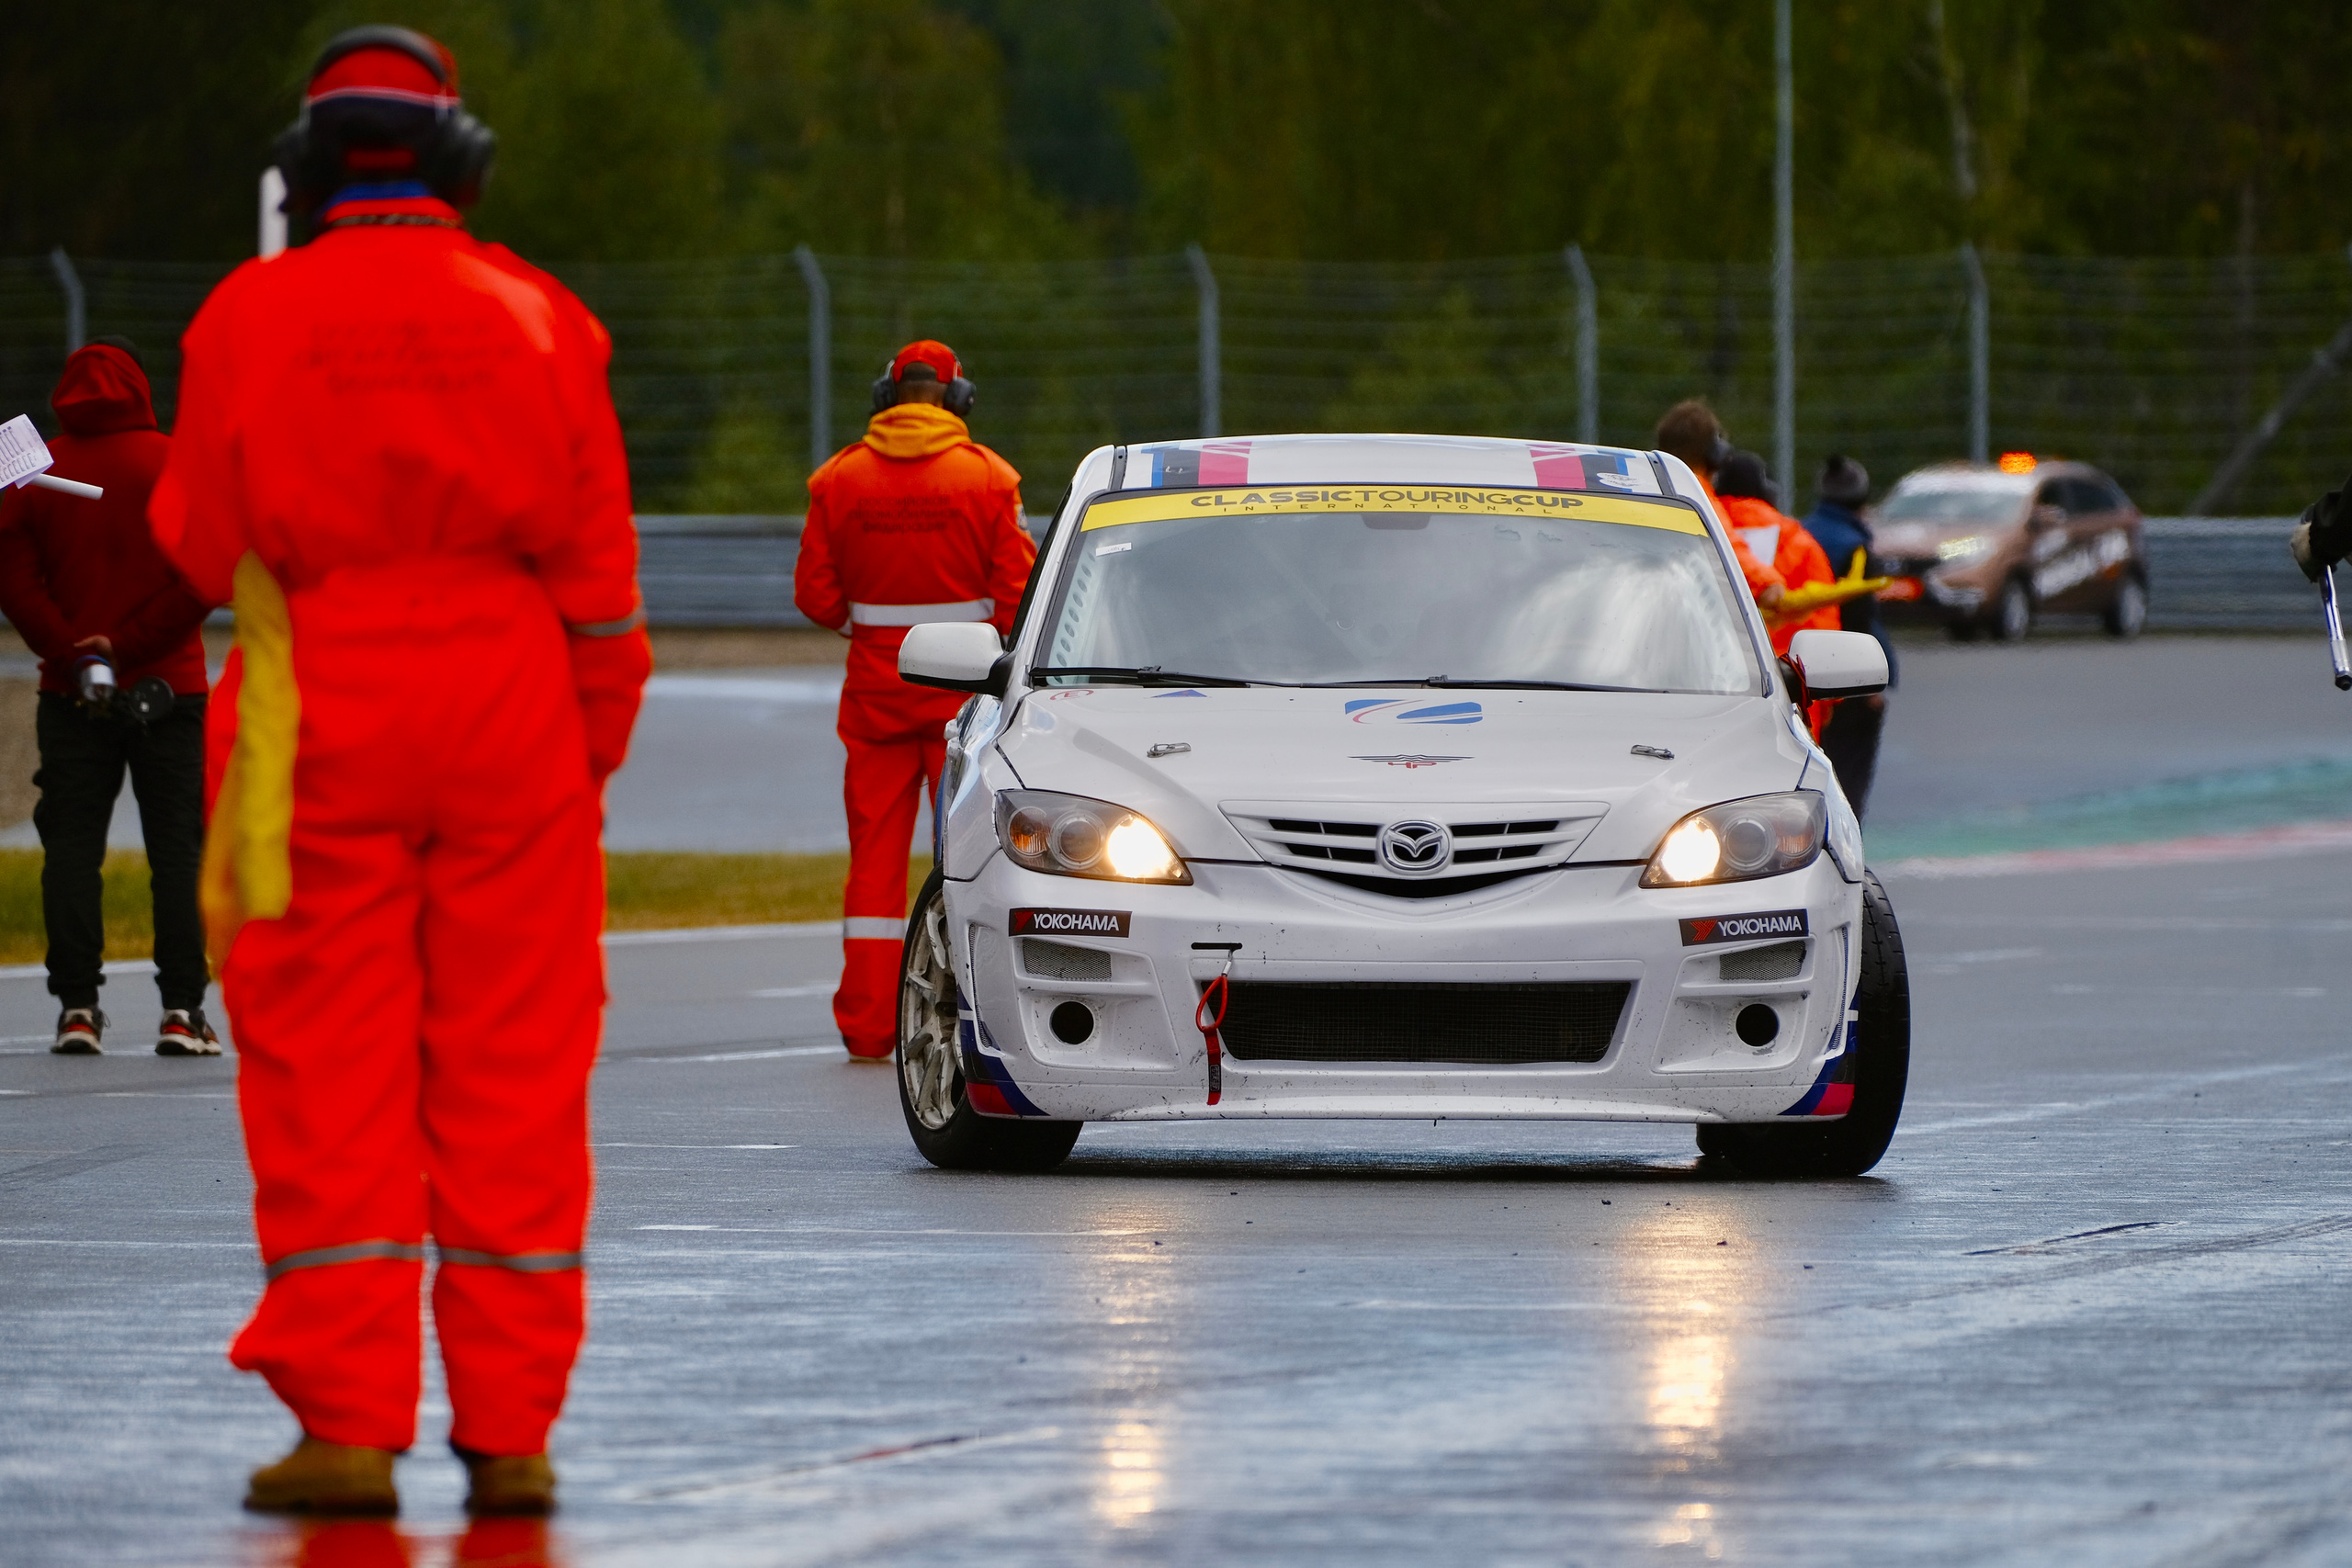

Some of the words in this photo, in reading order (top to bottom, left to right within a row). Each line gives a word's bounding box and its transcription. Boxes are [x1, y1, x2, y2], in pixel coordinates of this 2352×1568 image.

[1224, 502, 1554, 514] INTERNATIONAL
[1033, 913, 1120, 931] YOKOHAMA
[1718, 915, 1803, 937] YOKOHAMA
